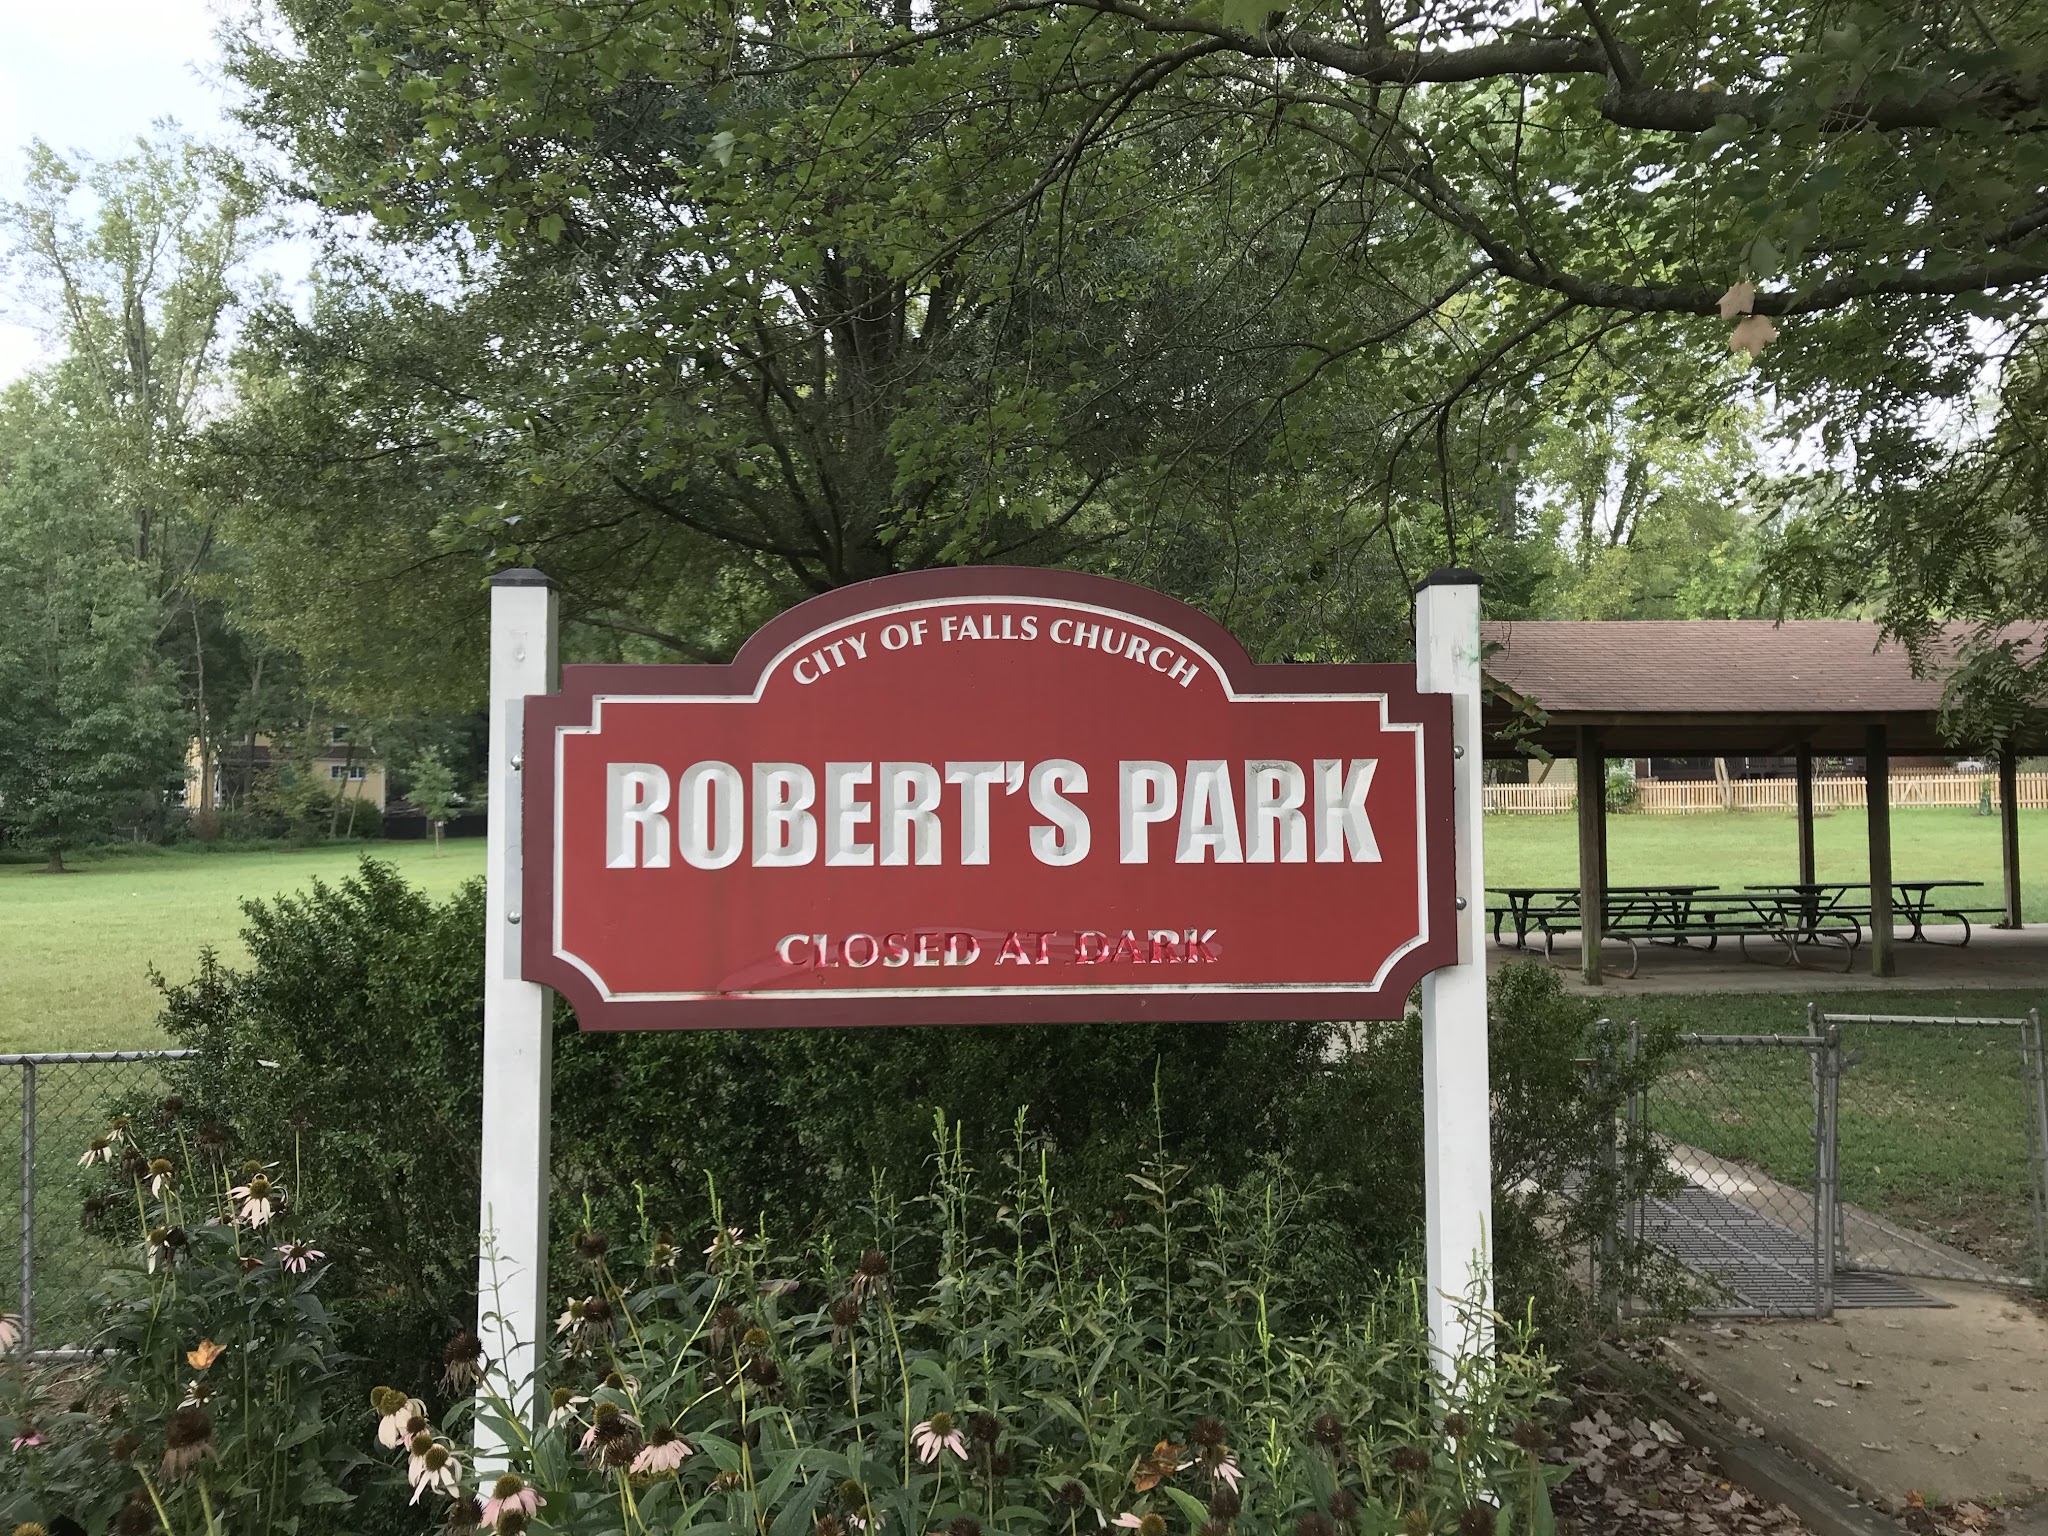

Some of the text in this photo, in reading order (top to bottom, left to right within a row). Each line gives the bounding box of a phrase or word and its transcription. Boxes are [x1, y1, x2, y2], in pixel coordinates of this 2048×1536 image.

[792, 614, 1200, 689] CITY OF FALLS CHURCH
[605, 759, 1383, 869] ROBERT'S PARK
[775, 928, 1218, 968] CLOSED AT DARK
